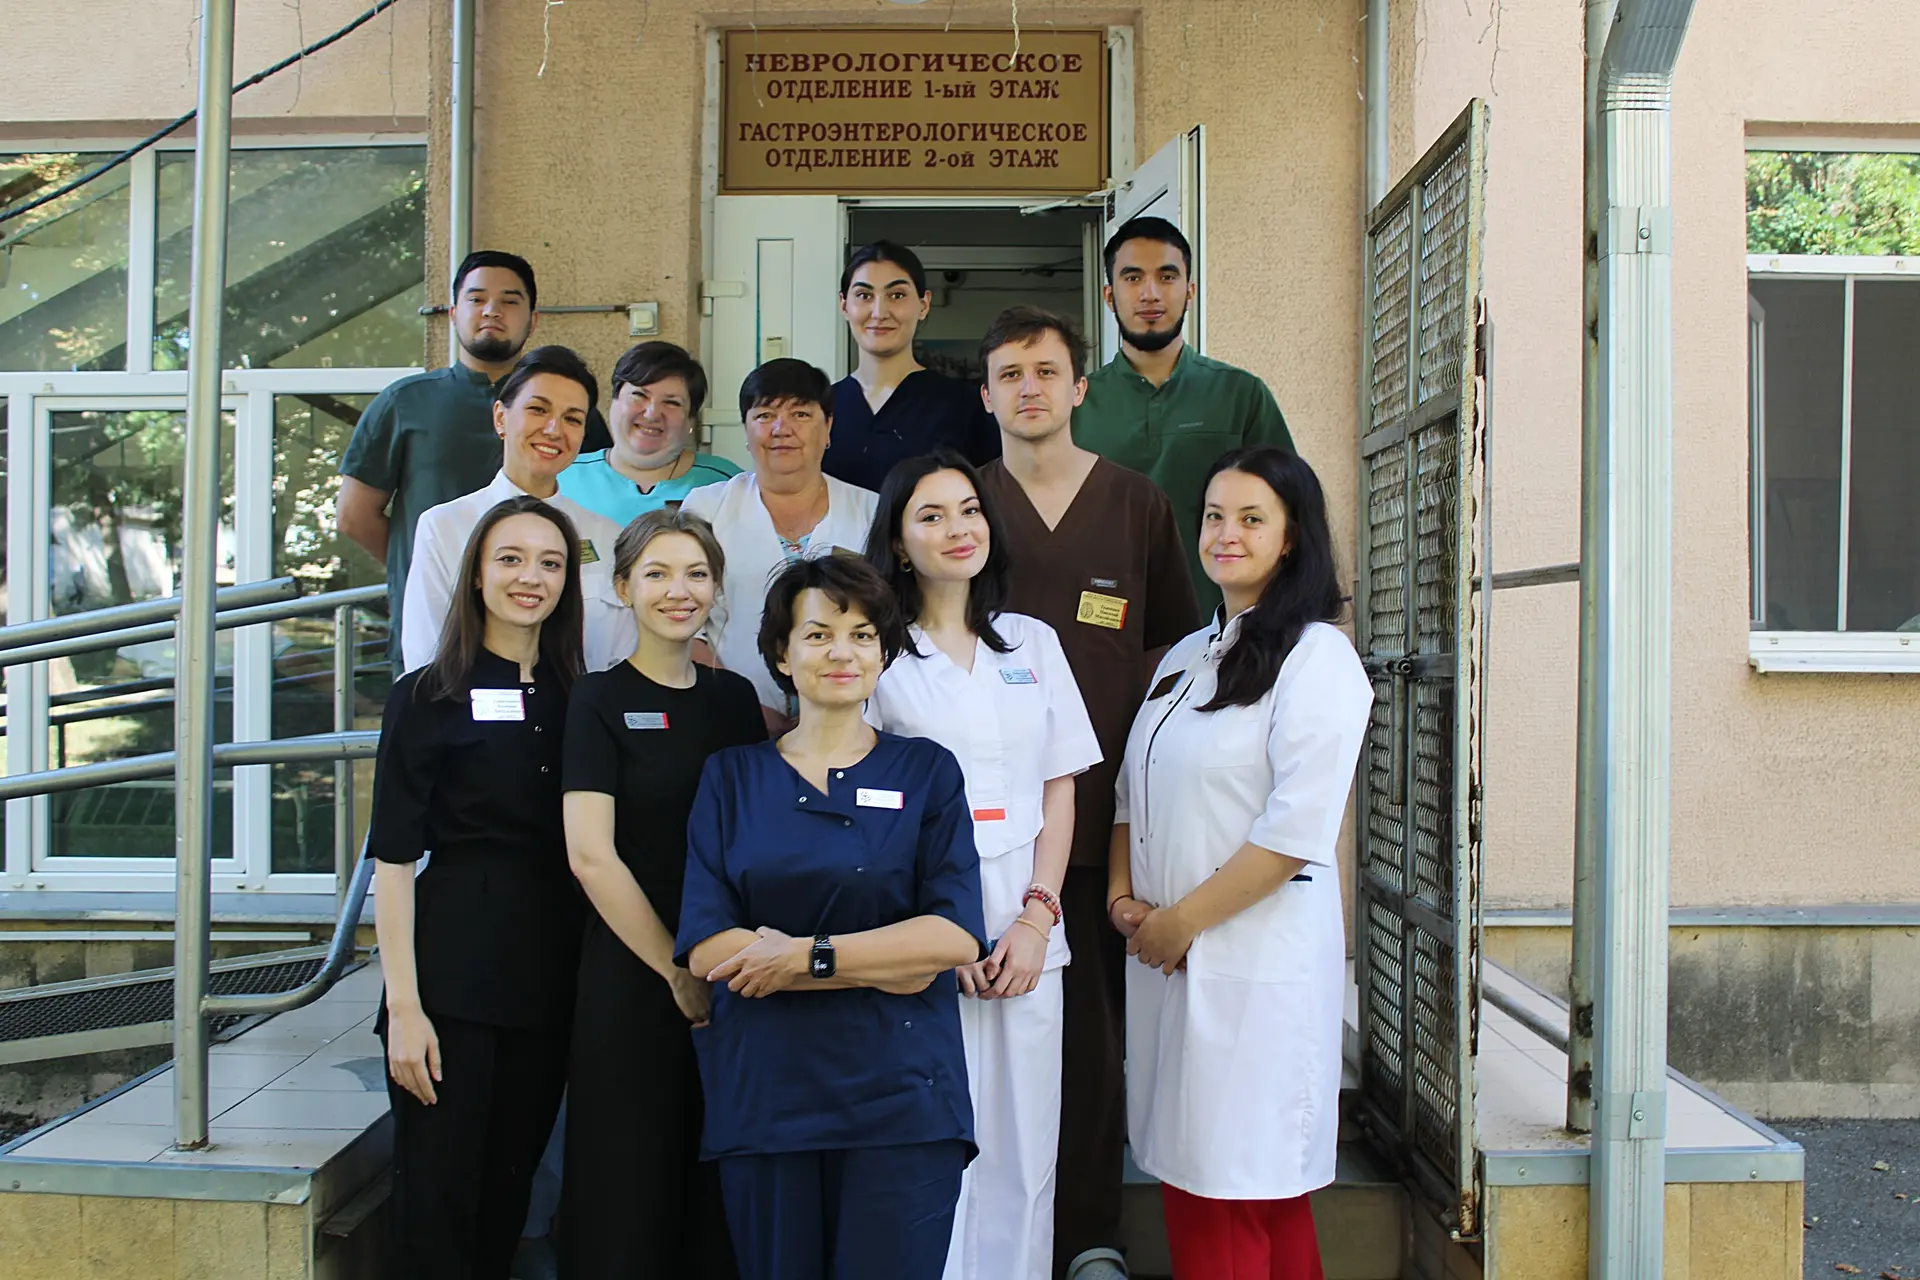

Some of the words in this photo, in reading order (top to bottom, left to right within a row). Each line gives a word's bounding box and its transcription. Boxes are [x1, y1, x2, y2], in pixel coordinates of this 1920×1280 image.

[745, 53, 1083, 73] НЕВРОЛОГИЧЕСКОЕ
[767, 79, 913, 104] ОТДЕЛЕНИЕ
[924, 79, 976, 99] 1-ый
[989, 79, 1060, 99] ЭТАЖ
[738, 122, 1088, 142] ГАСТРОЭНТЕРОЛОГИЧЕСКОЕ
[765, 148, 912, 173] ОТДЕЛЕНИЕ
[924, 148, 975, 168] 2-ой
[989, 148, 1059, 168] ЭТАЖ
